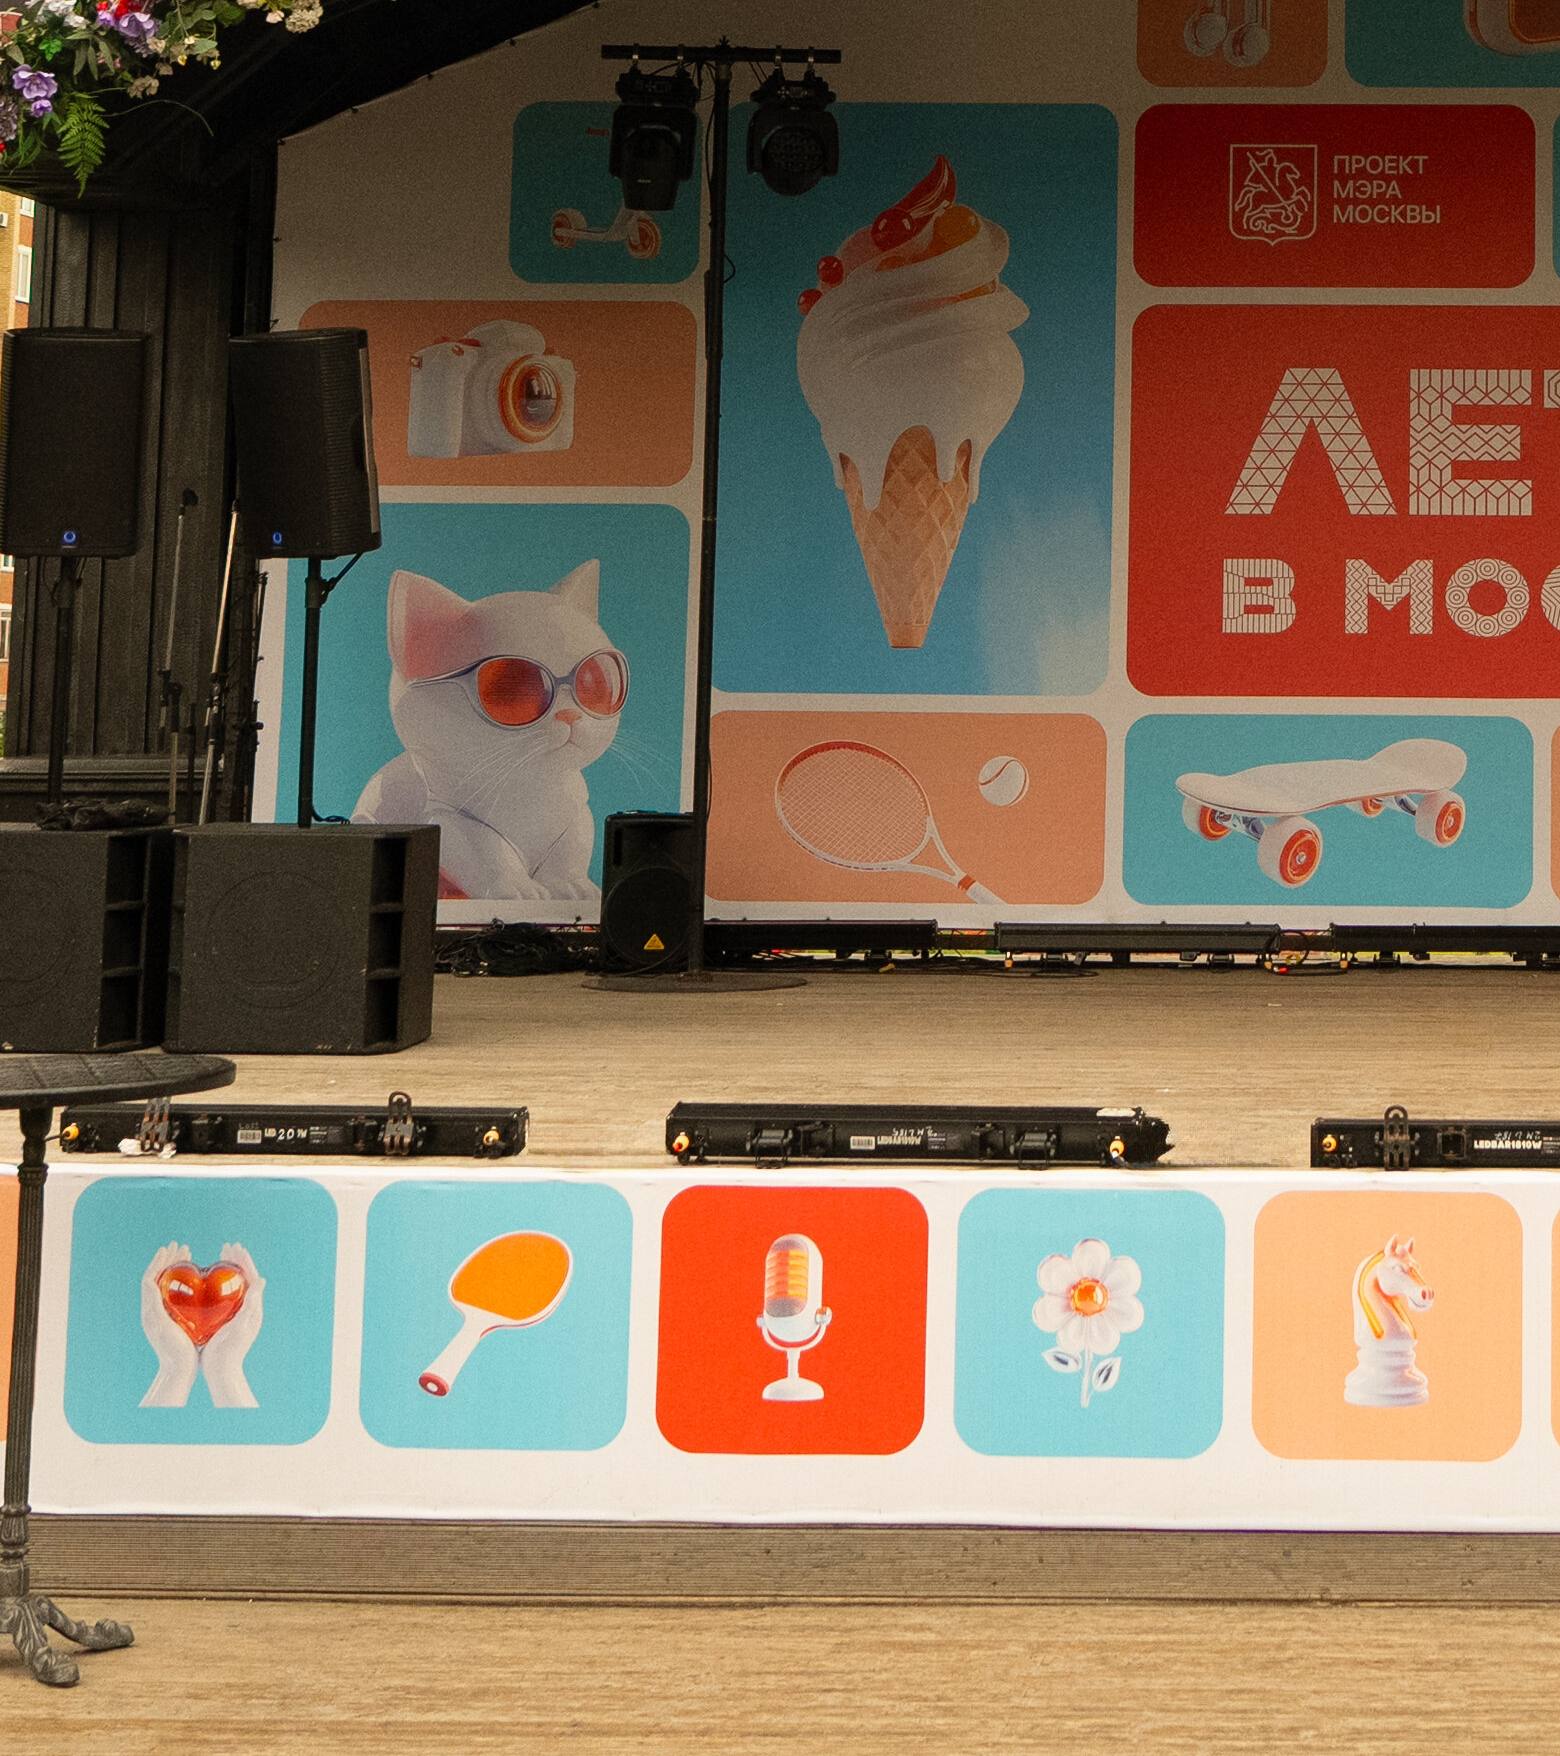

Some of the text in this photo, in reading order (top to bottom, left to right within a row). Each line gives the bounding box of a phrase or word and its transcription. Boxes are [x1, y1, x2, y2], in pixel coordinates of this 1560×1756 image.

[1333, 154, 1429, 175] ПРОЕКТ
[1333, 179, 1403, 200] МЭРА
[1333, 204, 1441, 225] МОСКВЫ
[1221, 558, 1297, 634] В
